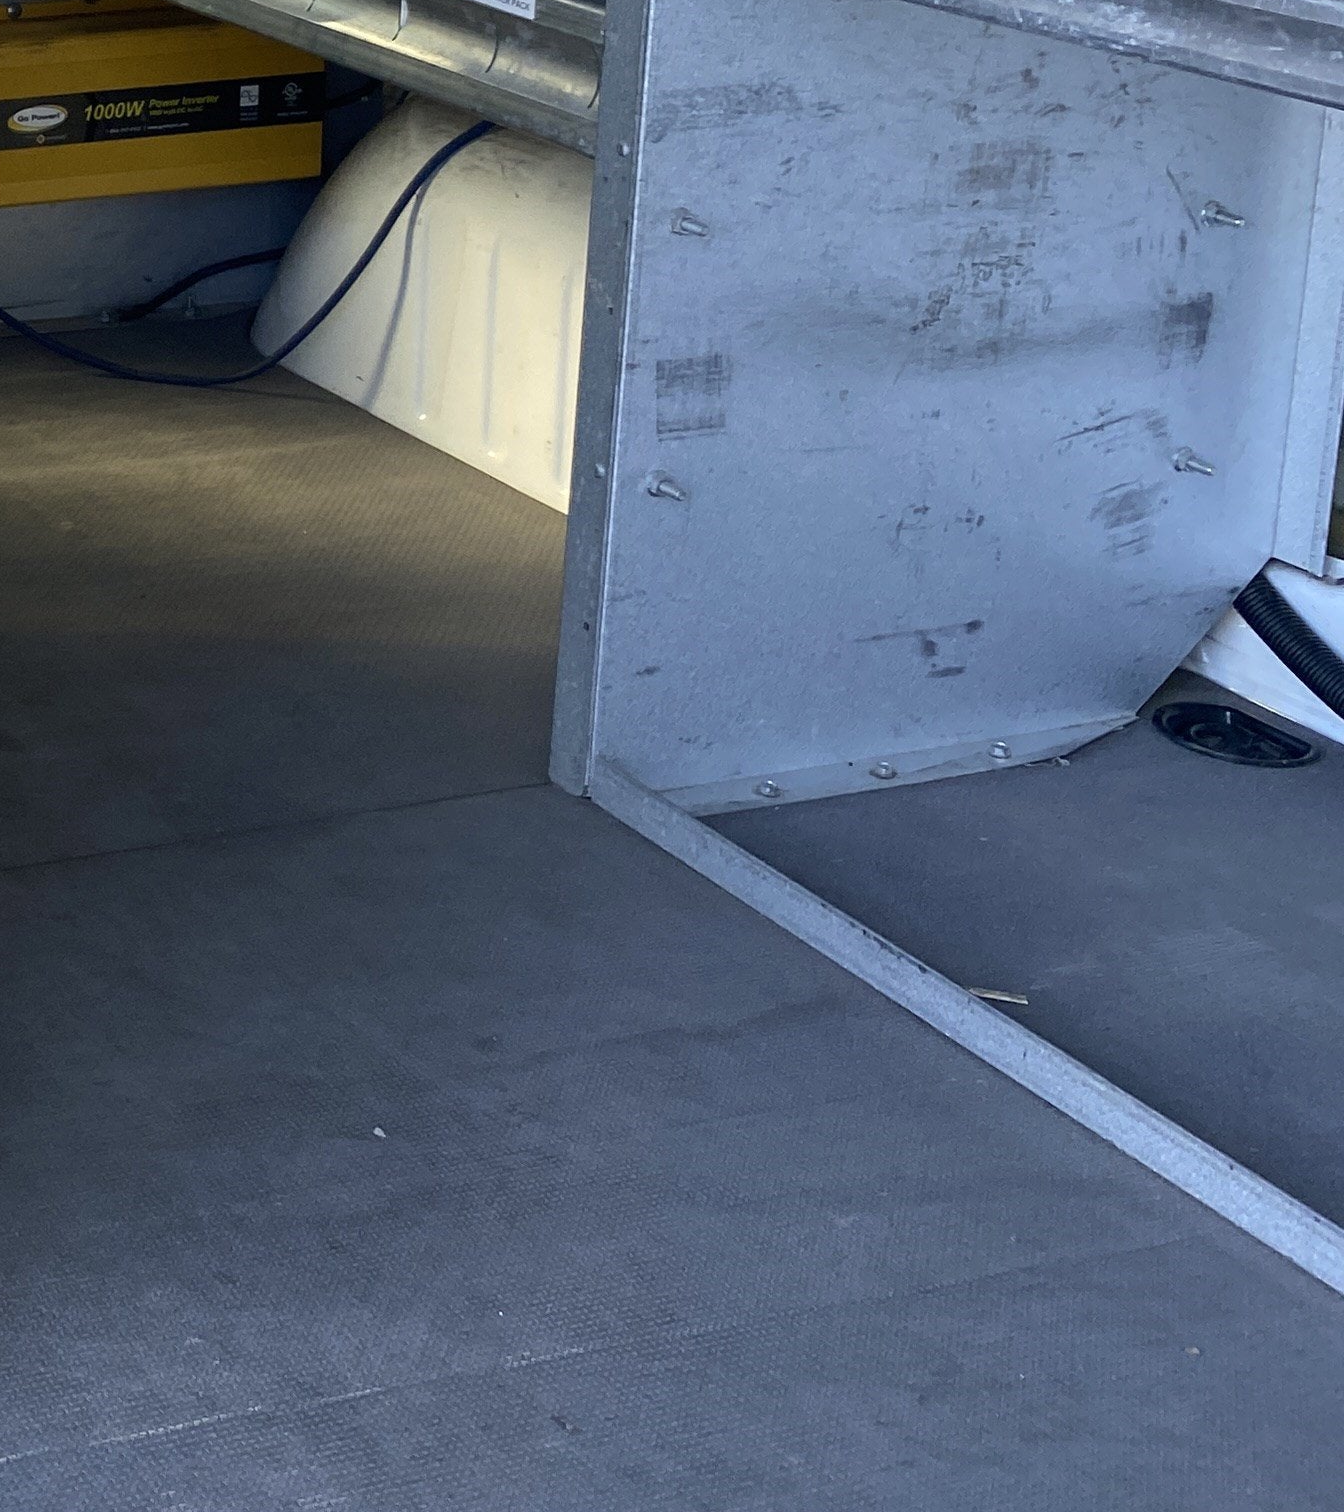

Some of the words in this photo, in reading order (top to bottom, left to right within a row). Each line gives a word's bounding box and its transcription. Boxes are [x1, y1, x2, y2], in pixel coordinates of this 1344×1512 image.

[84, 100, 146, 122] 1000W
[148, 98, 180, 109] Power
[181, 95, 220, 105] Inverter
[17, 114, 29, 123] Go
